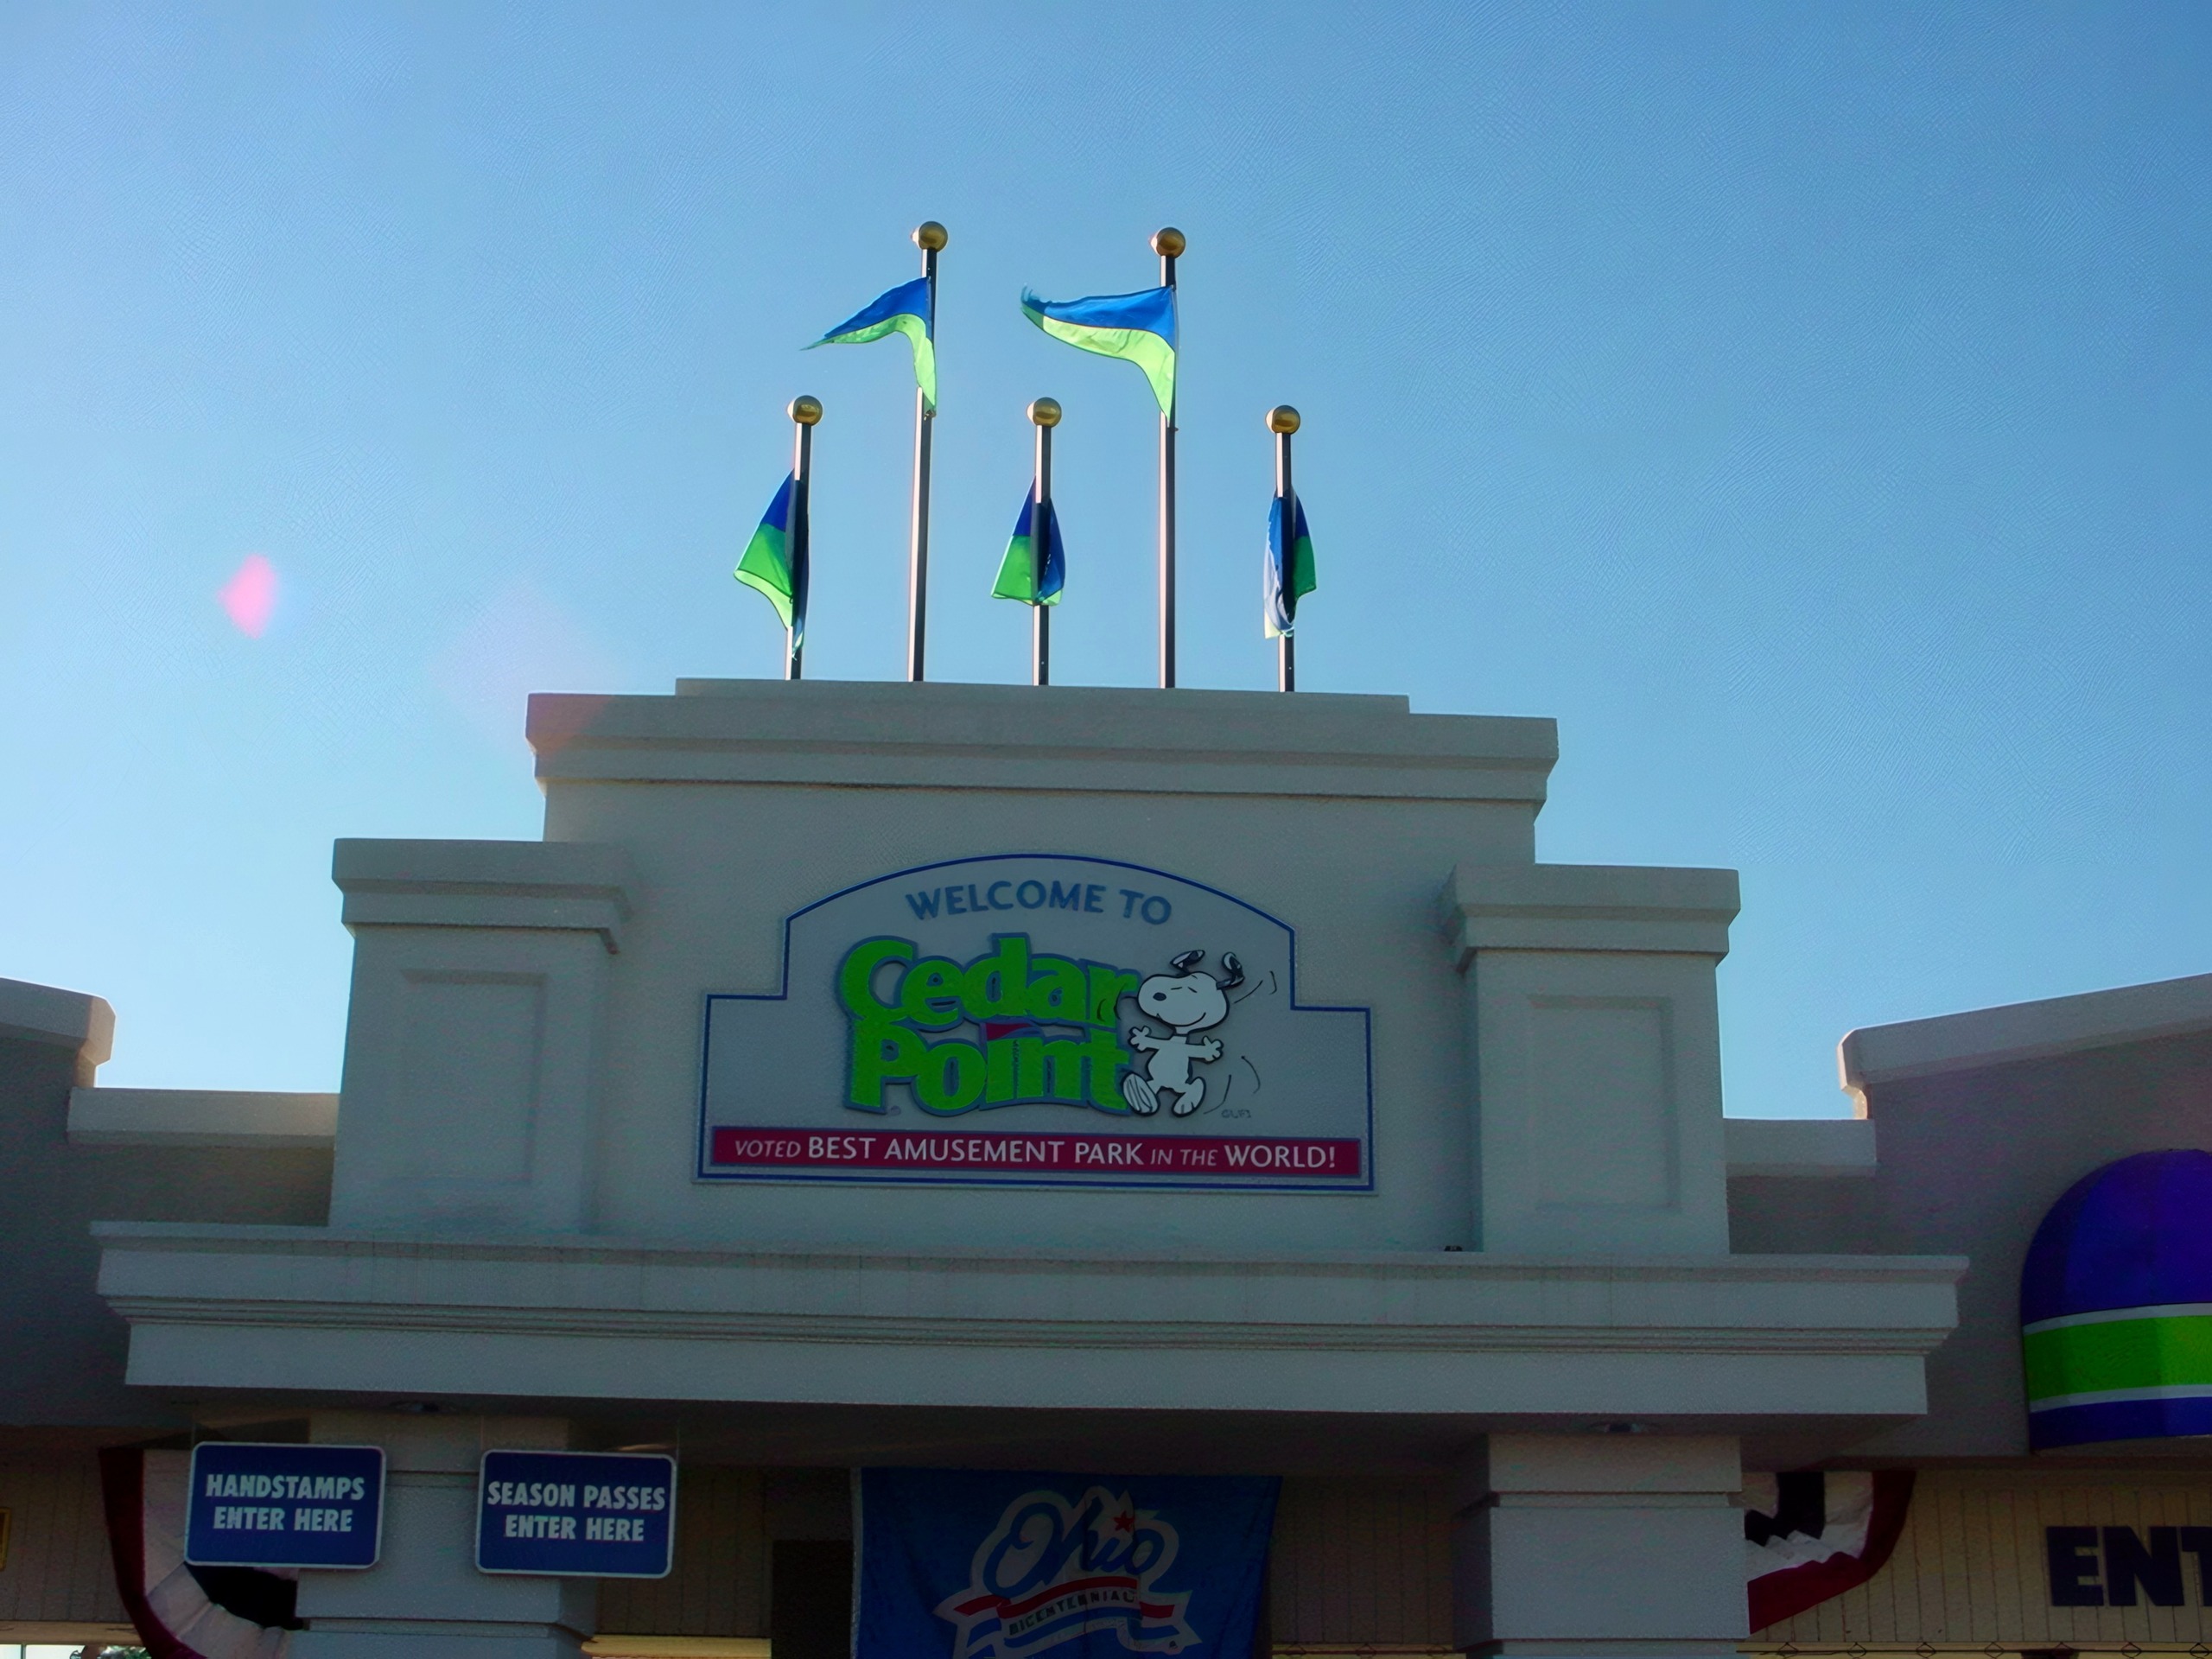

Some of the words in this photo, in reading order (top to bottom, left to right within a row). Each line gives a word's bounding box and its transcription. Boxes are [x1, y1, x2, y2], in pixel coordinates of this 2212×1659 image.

[906, 880, 1107, 920] WELCOME
[1119, 888, 1172, 925] TO
[838, 935, 1140, 1031] Cedar
[845, 1020, 1134, 1115] Point
[734, 1139, 803, 1159] VOTED
[807, 1135, 878, 1160] BEST
[884, 1137, 1065, 1164] AMUSEMENT
[1074, 1141, 1145, 1166] PARK
[1150, 1147, 1174, 1166] IN
[1179, 1147, 1219, 1168] THE
[1224, 1144, 1336, 1169] WORLD!
[205, 1473, 366, 1501] HANDSTAMPS
[486, 1480, 576, 1508] SEASON
[582, 1484, 666, 1511] PASSES
[213, 1506, 286, 1531] ENTER
[293, 1508, 354, 1533] HERE
[505, 1514, 578, 1541] ENTER
[585, 1516, 645, 1542] HERE
[982, 1496, 1166, 1598] Ohio
[1009, 1589, 1136, 1635] BICENTENNIAL
